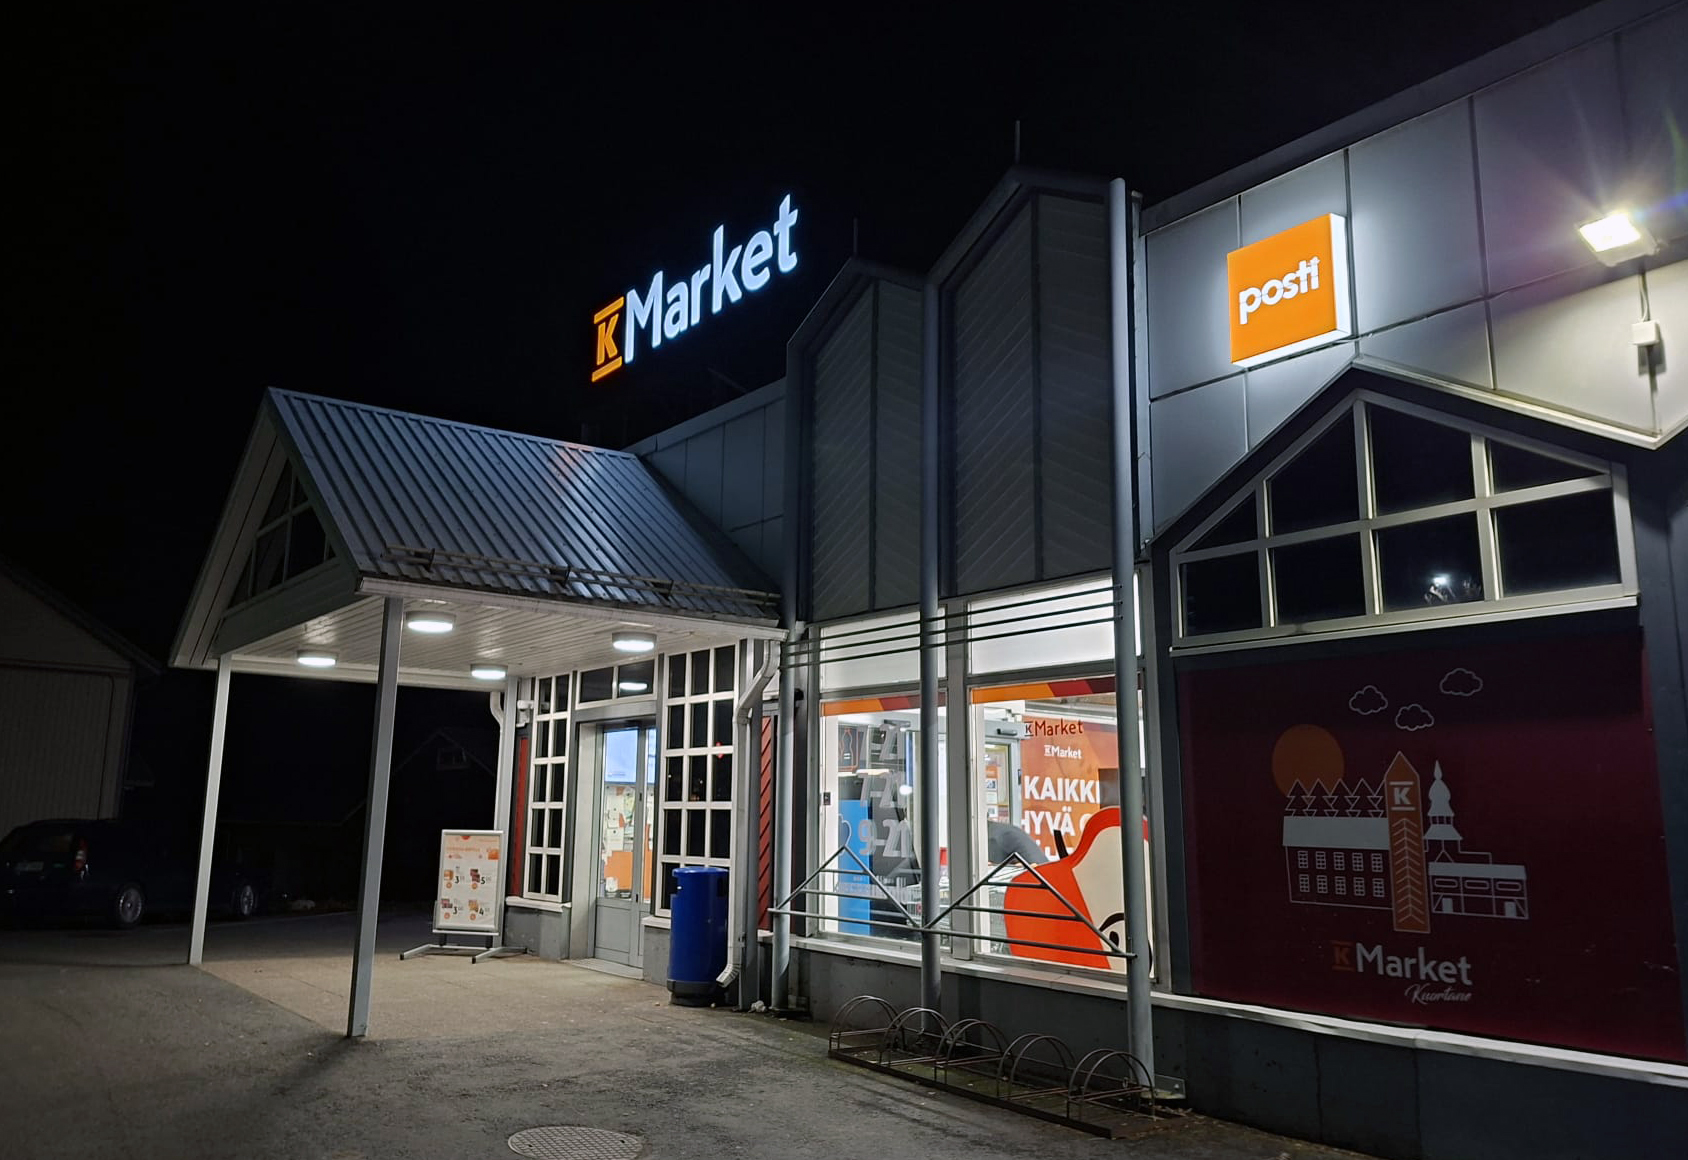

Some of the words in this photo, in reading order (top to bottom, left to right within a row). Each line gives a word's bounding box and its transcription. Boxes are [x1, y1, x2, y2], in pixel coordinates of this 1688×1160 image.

[625, 193, 798, 364] Market
[1238, 256, 1320, 325] posti
[1035, 718, 1084, 737] Market
[1051, 746, 1082, 760] Market
[1024, 775, 1100, 804] KAIKKI
[1021, 805, 1076, 837] HYVÄ
[1356, 942, 1473, 986] Market
